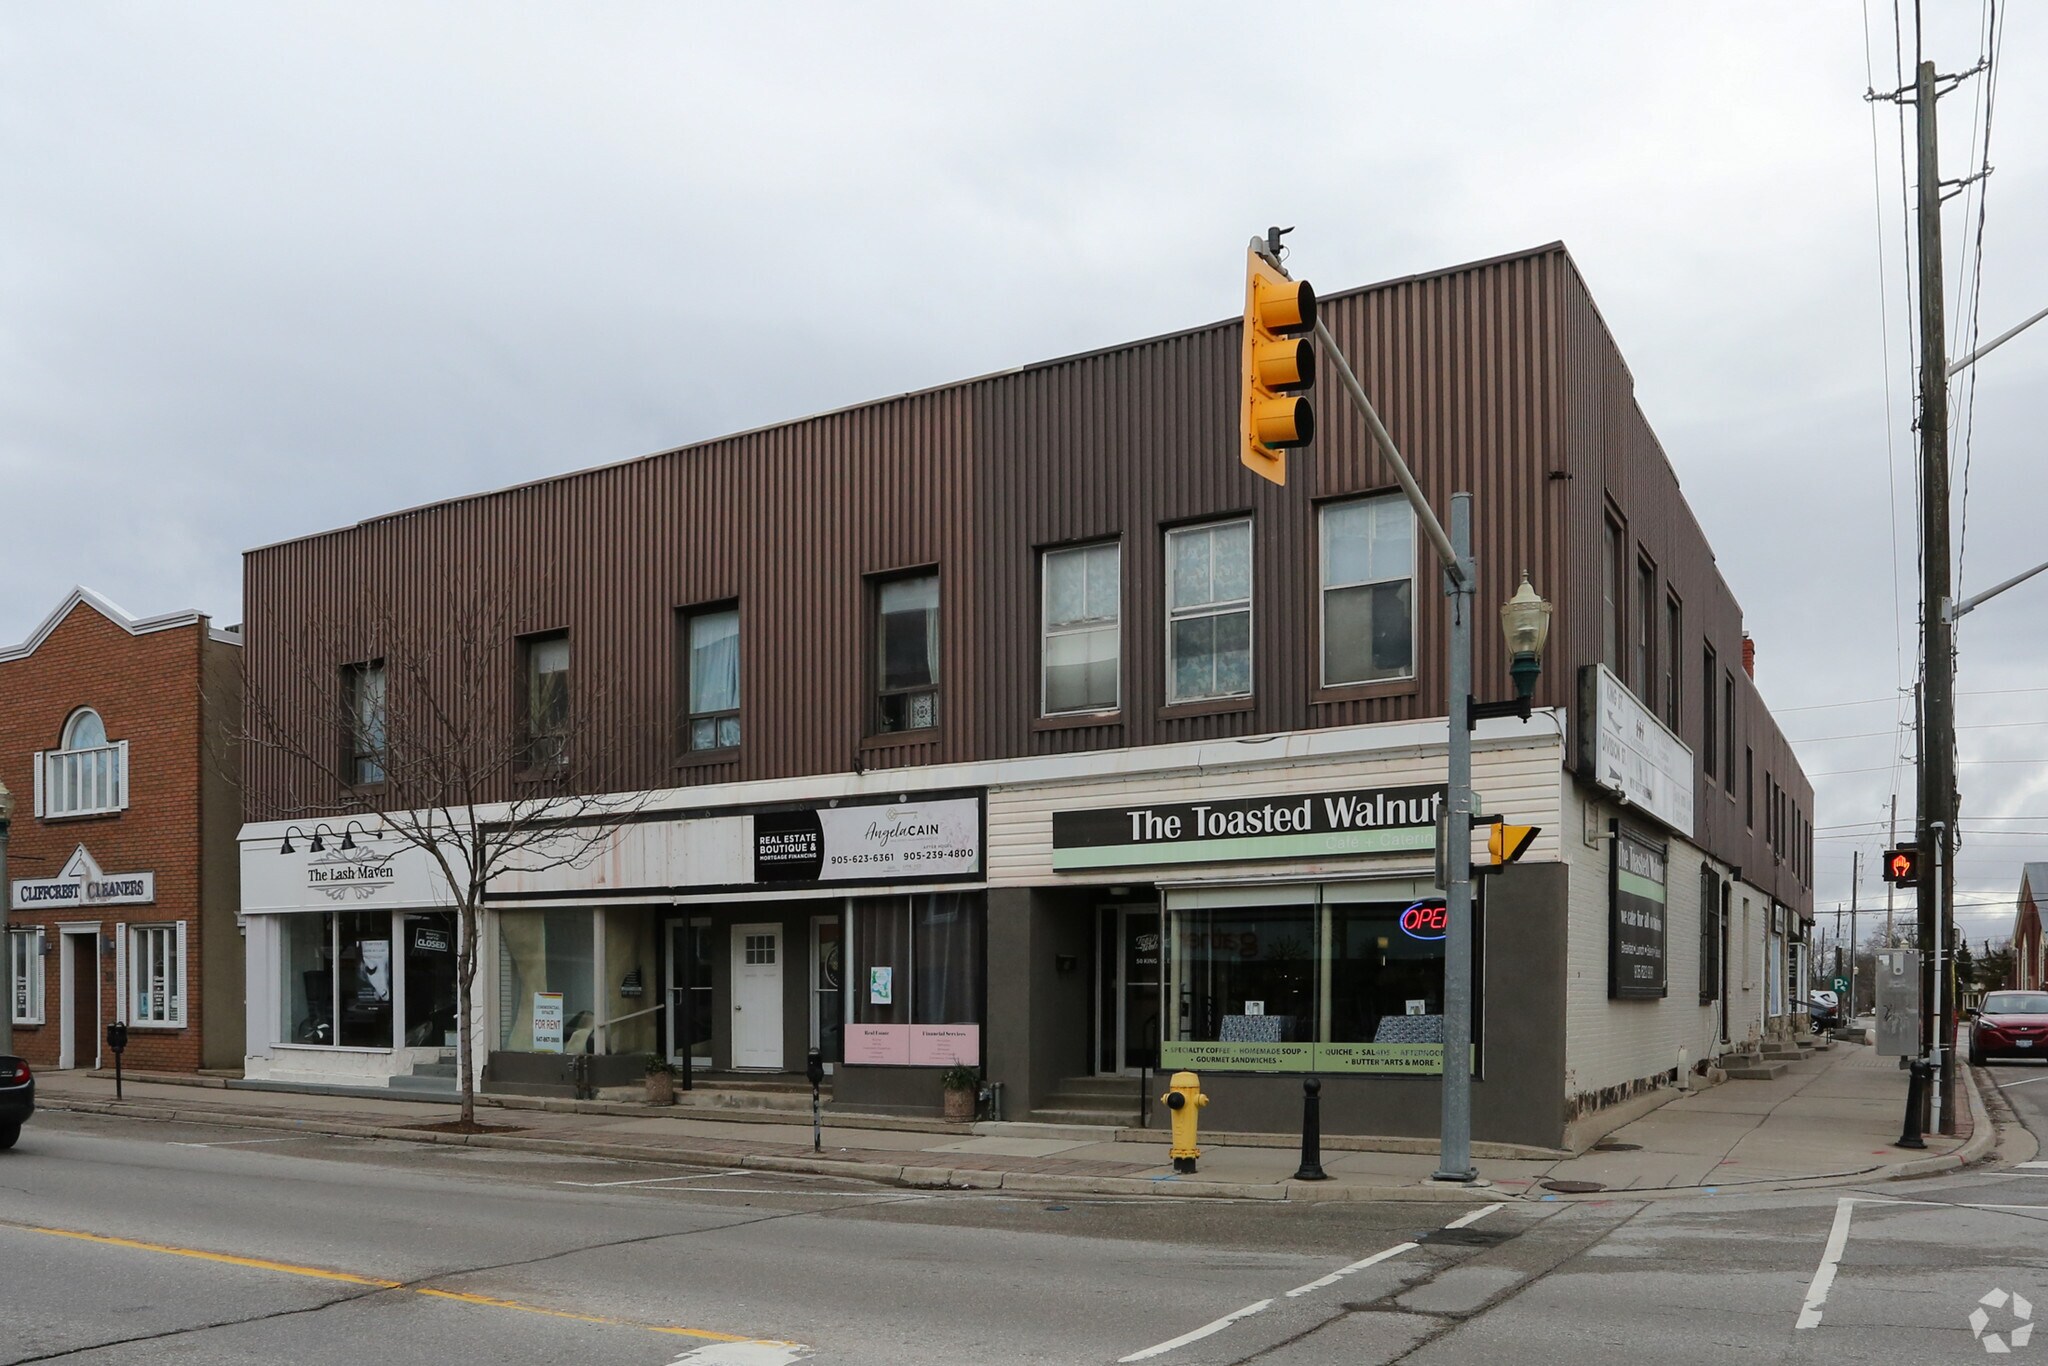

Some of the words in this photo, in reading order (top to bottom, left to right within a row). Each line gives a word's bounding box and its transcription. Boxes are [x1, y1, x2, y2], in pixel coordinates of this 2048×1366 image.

[1127, 810, 1181, 840] The
[1191, 798, 1311, 837] Toasted
[1324, 791, 1443, 829] Walnut
[760, 836, 781, 844] REAL
[784, 833, 817, 843] ESTATE
[1326, 835, 1359, 849] Café
[1380, 832, 1436, 846] Caterin
[760, 843, 807, 854] BOUTIQUE
[810, 843, 816, 851] &
[904, 849, 974, 860] 905-239-4800
[831, 853, 894, 864] 905-623-6361
[1618, 841, 1628, 869] The
[1629, 845, 1649, 877] Toasted
[308, 868, 327, 881] The
[331, 867, 354, 880] Lash
[358, 866, 393, 879] Maven
[21, 883, 80, 902] CLIFFCREST
[87, 880, 144, 899] CLEANERS
[1404, 908, 1447, 929] OPE
[417, 939, 446, 949] CLOSED
[535, 1020, 545, 1029] FOR
[546, 1020, 560, 1030] RENT
